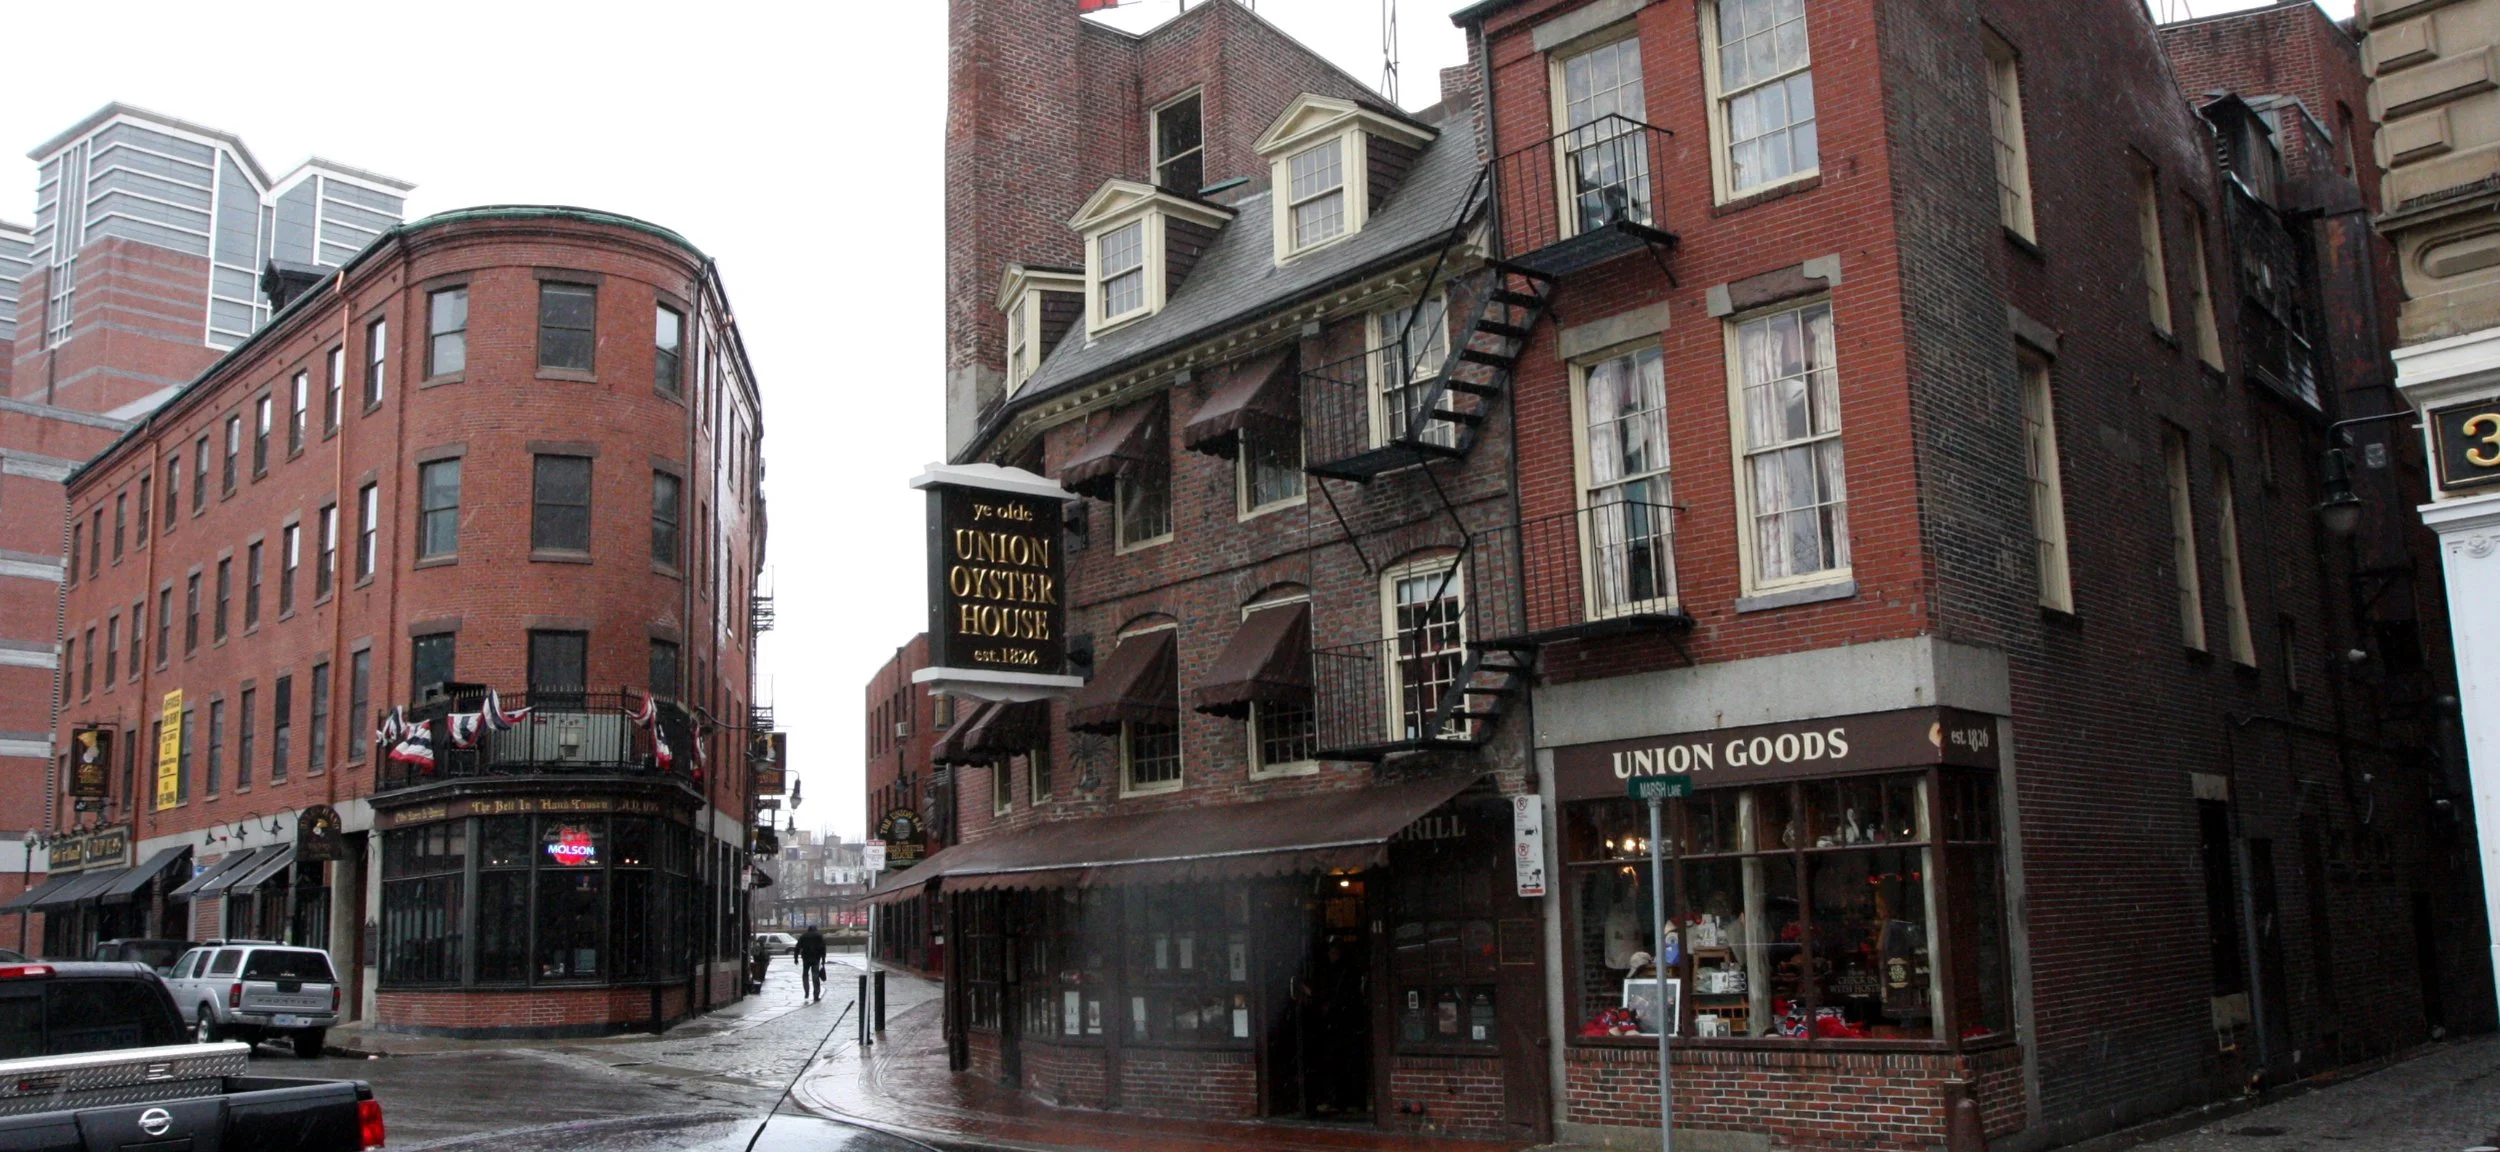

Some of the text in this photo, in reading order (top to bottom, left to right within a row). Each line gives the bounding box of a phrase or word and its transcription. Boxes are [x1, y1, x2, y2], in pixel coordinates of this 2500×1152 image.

[974, 500, 1033, 521] ye olde
[954, 528, 1049, 569] UNION
[950, 565, 1058, 605] OYSTER
[959, 603, 1050, 641] HOUSE
[1951, 728, 1988, 753] est. 1826
[1612, 728, 1849, 779] UNION GOODS
[1640, 781, 1681, 798] MARSH LANE
[471, 801, 491, 813] The
[494, 800, 514, 813] Bell
[548, 844, 595, 856] MOLSON
